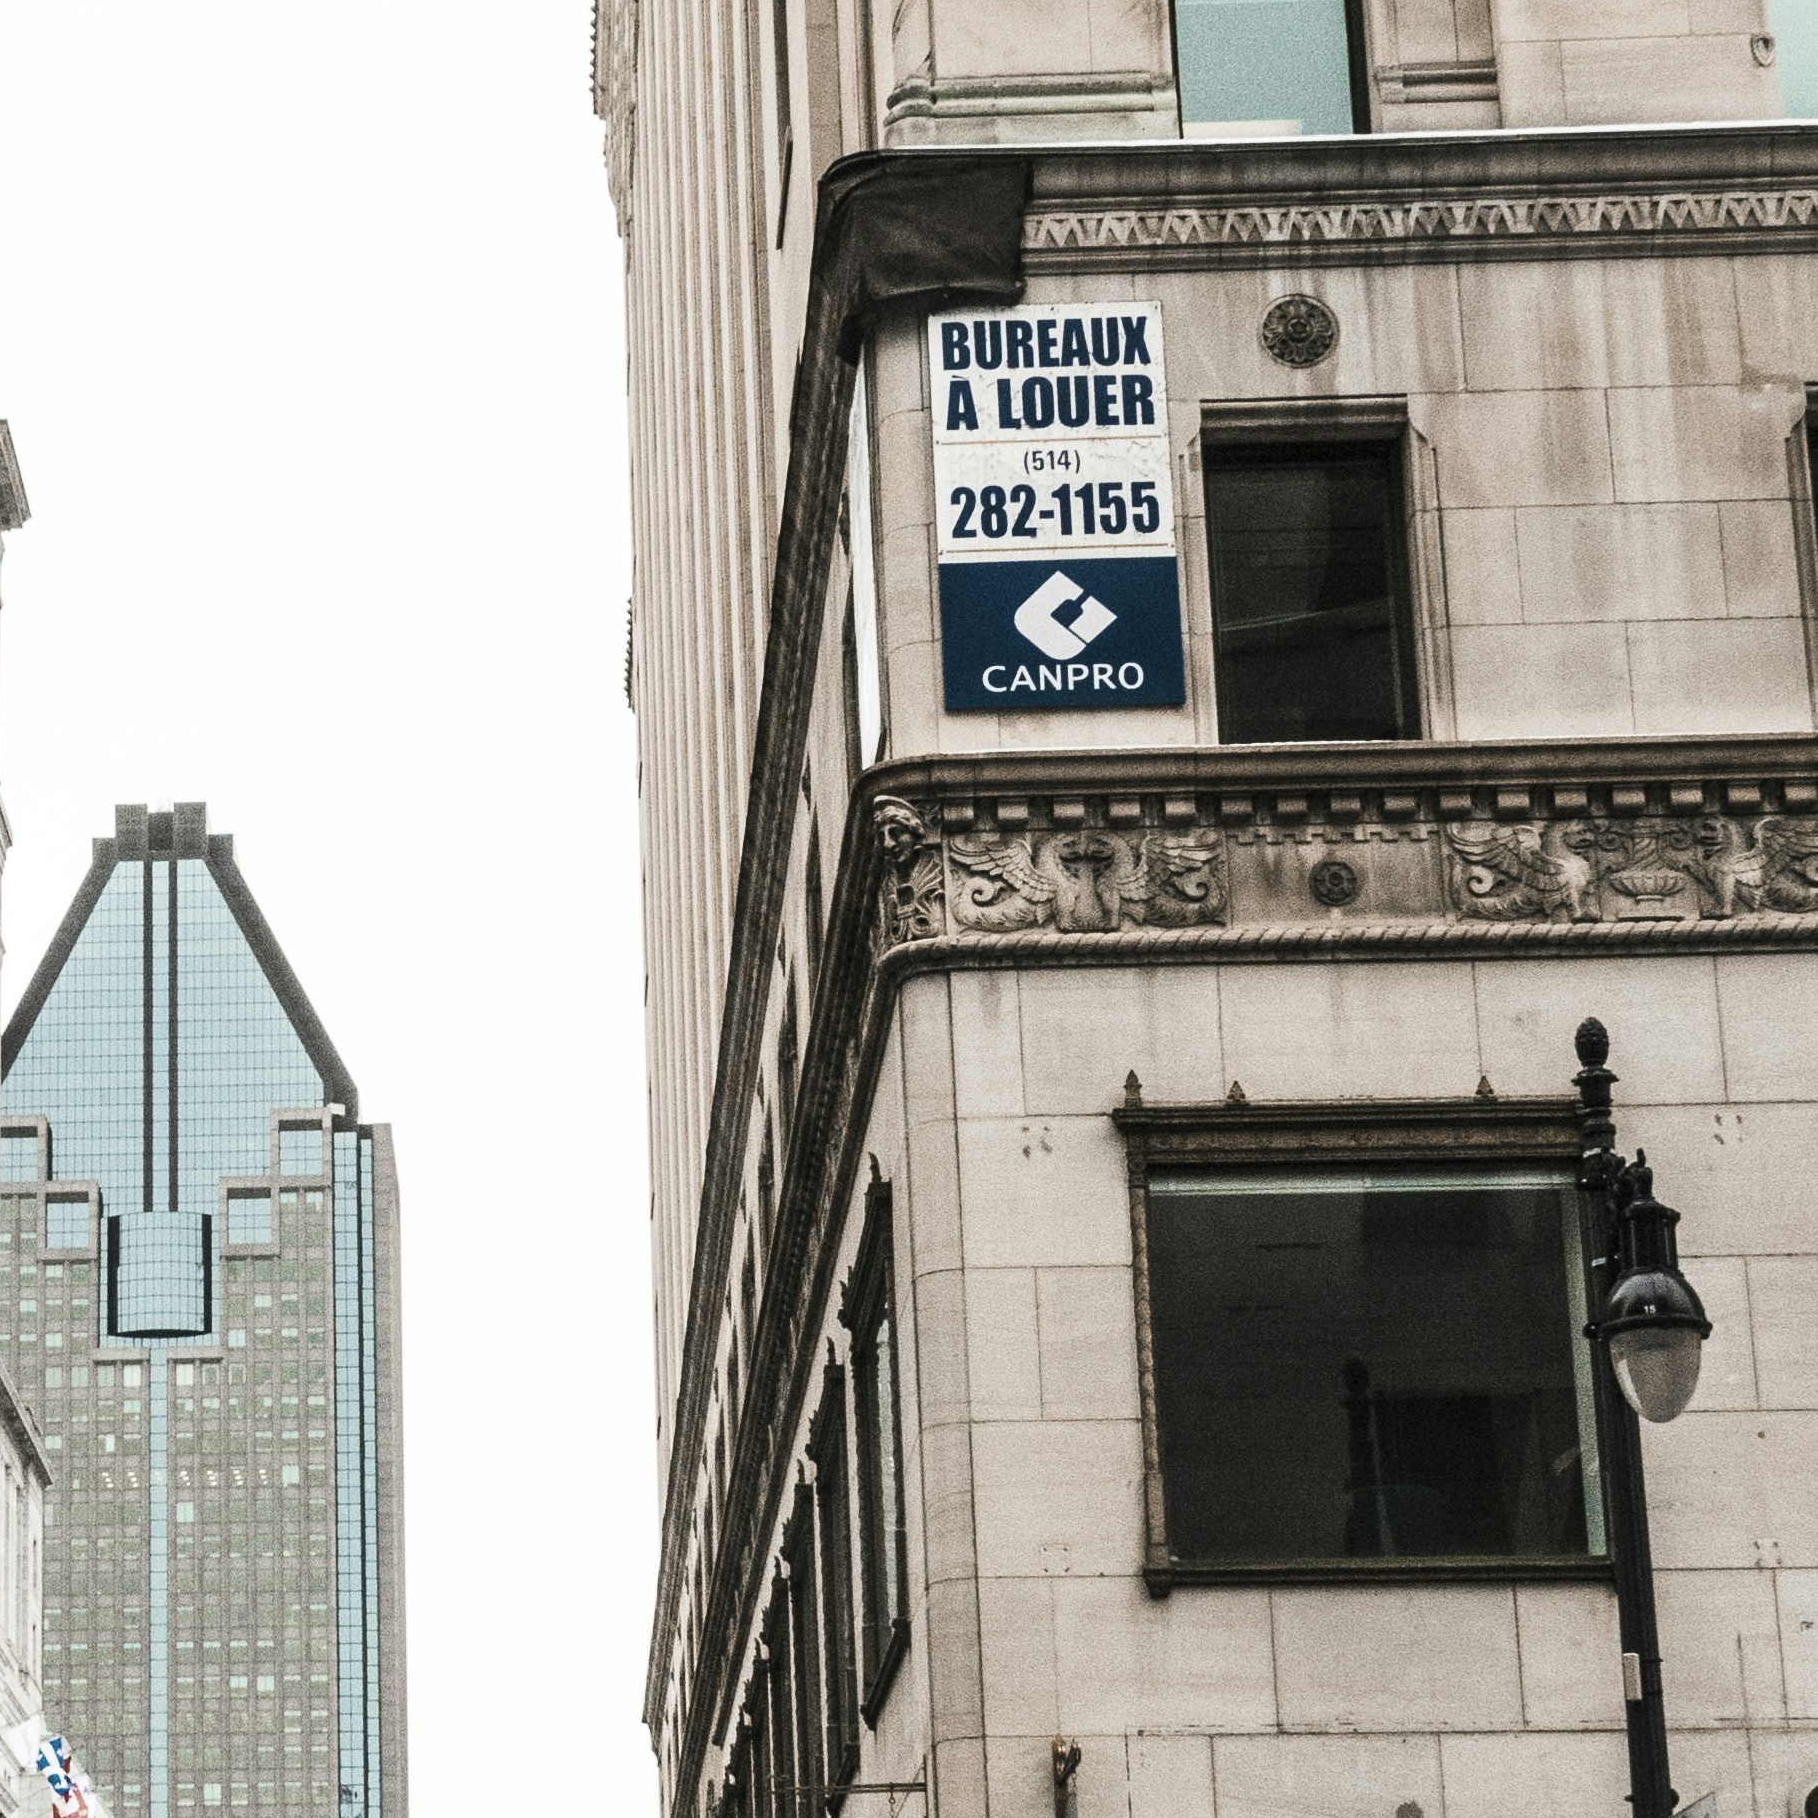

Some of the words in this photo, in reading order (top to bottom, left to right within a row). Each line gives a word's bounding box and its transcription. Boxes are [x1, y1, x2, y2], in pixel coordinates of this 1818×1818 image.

[941, 316, 1152, 371] BUREAUX
[945, 374, 979, 431] À
[997, 374, 1156, 430] LOUER
[1023, 449, 1081, 475] (514)
[950, 481, 1161, 539] 282-1155
[981, 662, 1145, 693] CANPRO
